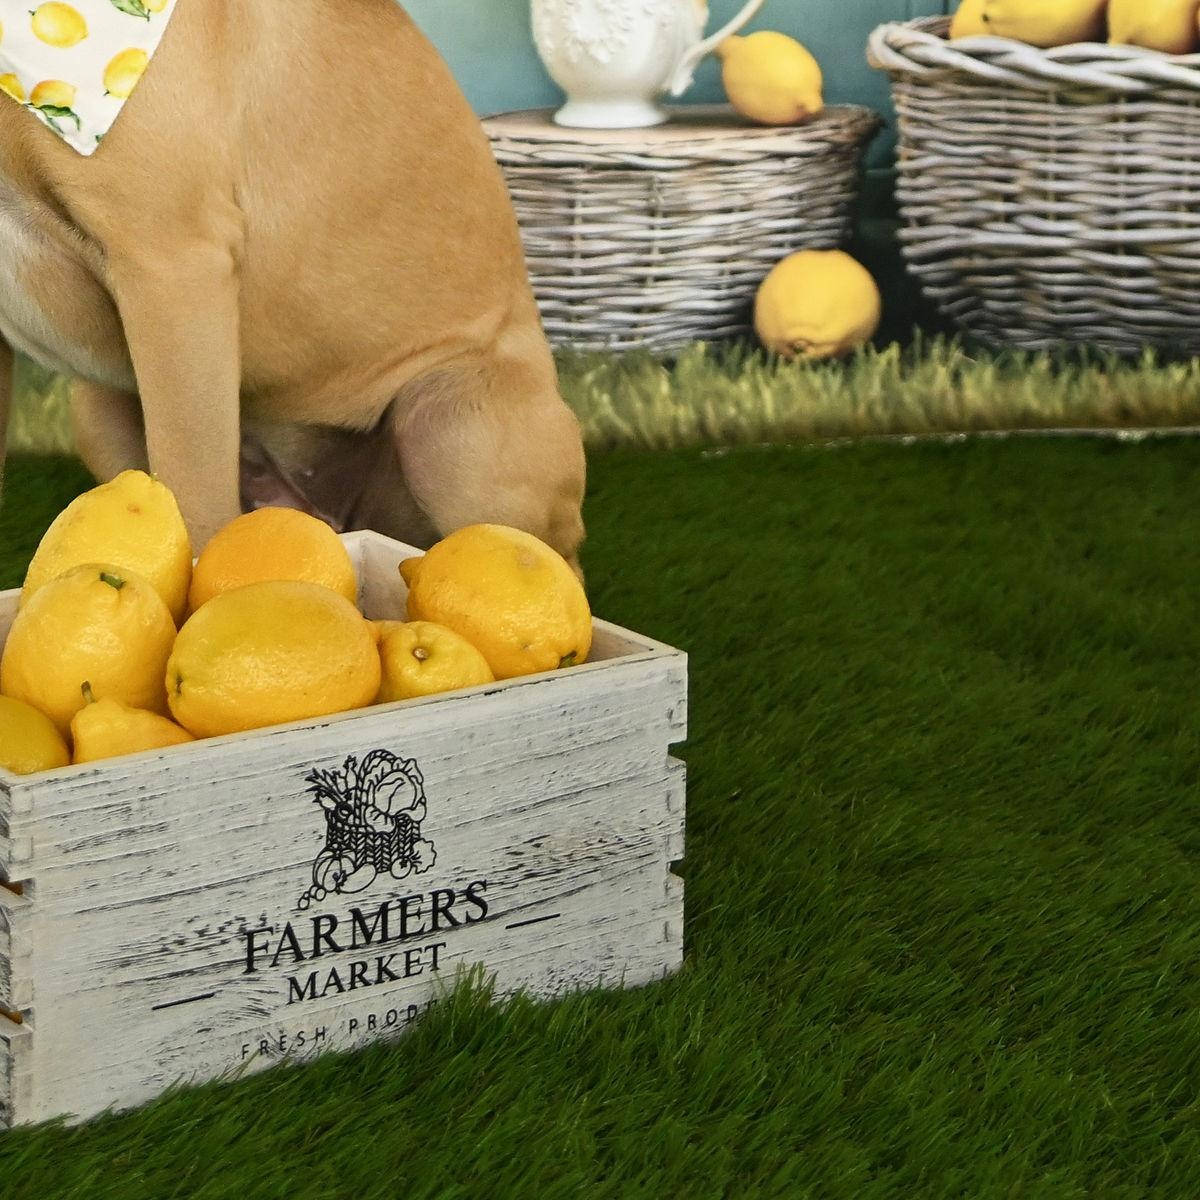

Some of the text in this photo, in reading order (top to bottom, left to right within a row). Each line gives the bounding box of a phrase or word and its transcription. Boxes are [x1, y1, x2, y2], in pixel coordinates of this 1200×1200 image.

[242, 879, 490, 974] FARMERS
[285, 941, 448, 1005] MARKET
[240, 999, 438, 1060] FRESH PROD
